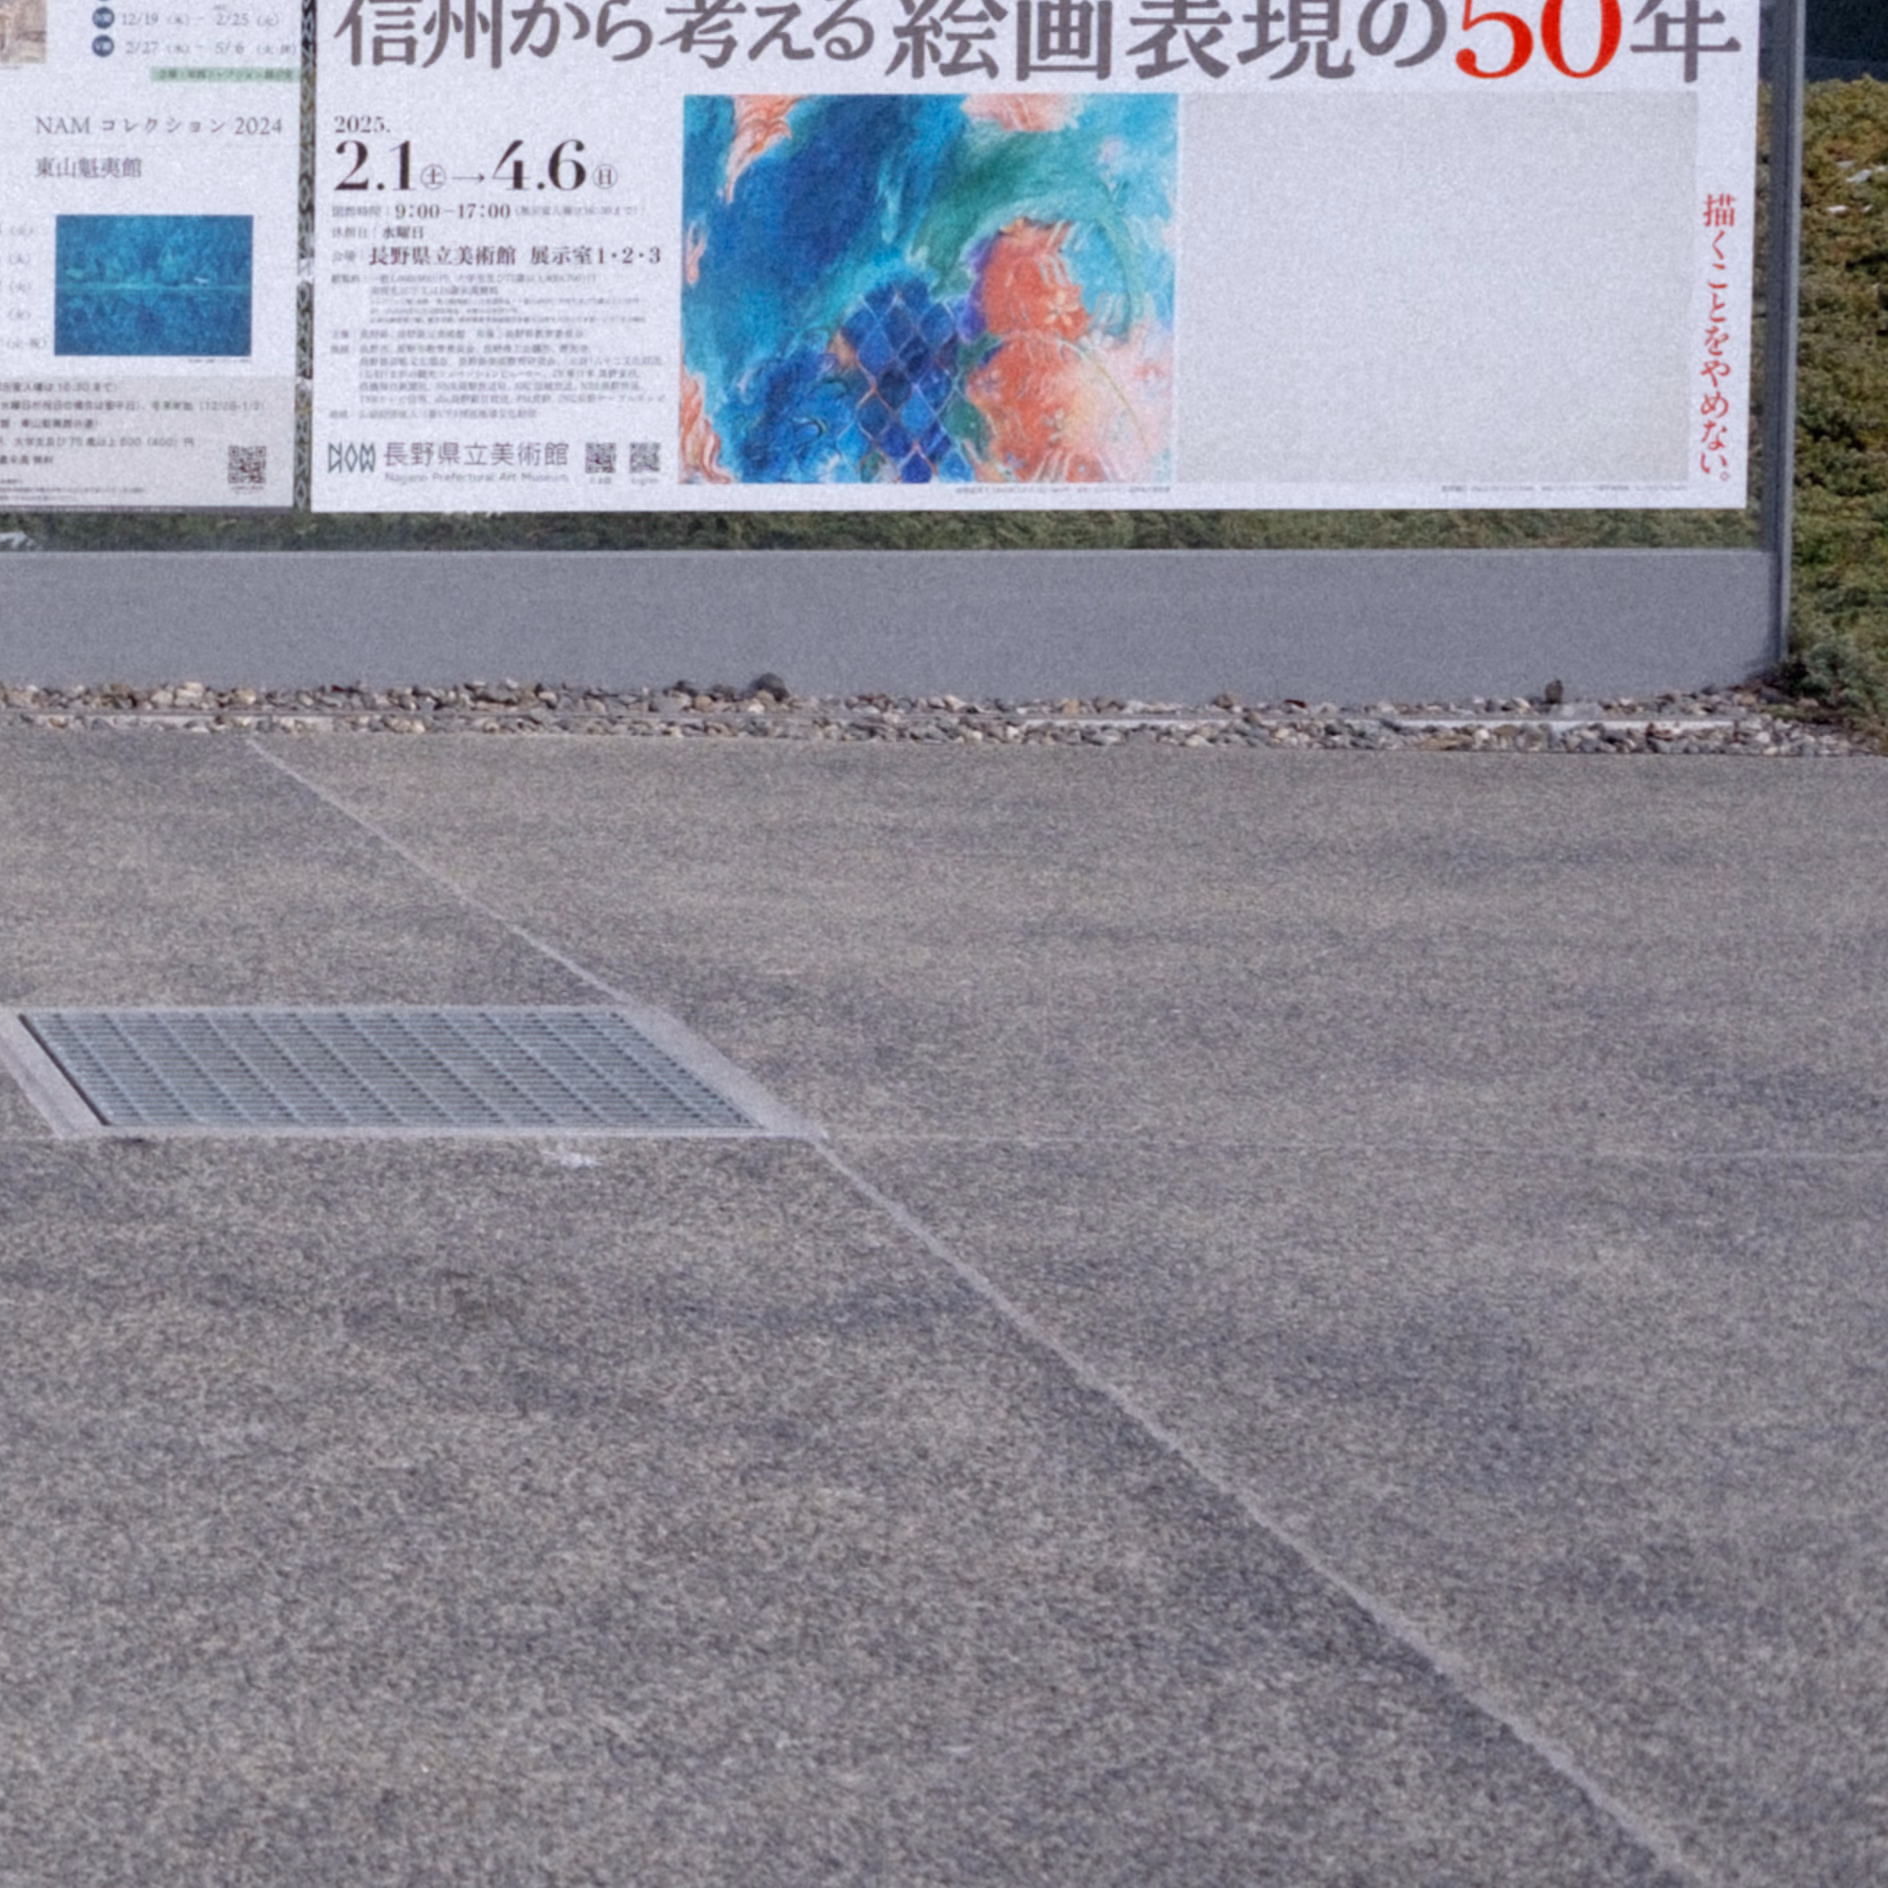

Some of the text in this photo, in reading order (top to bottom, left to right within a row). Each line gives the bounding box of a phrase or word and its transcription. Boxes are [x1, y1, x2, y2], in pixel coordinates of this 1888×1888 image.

[35, 116, 283, 135] NAM コレクション 2024
[334, 116, 391, 133] 2025.
[382, 226, 425, 240] 水曜日
[369, 245, 516, 266] 長野県立美術館
[1700, 193, 1736, 482] 描くことをやめない。
[384, 441, 569, 467] 長野県立美術館
[432, 473, 495, 483] Prefectural
[499, 473, 516, 483] Art
